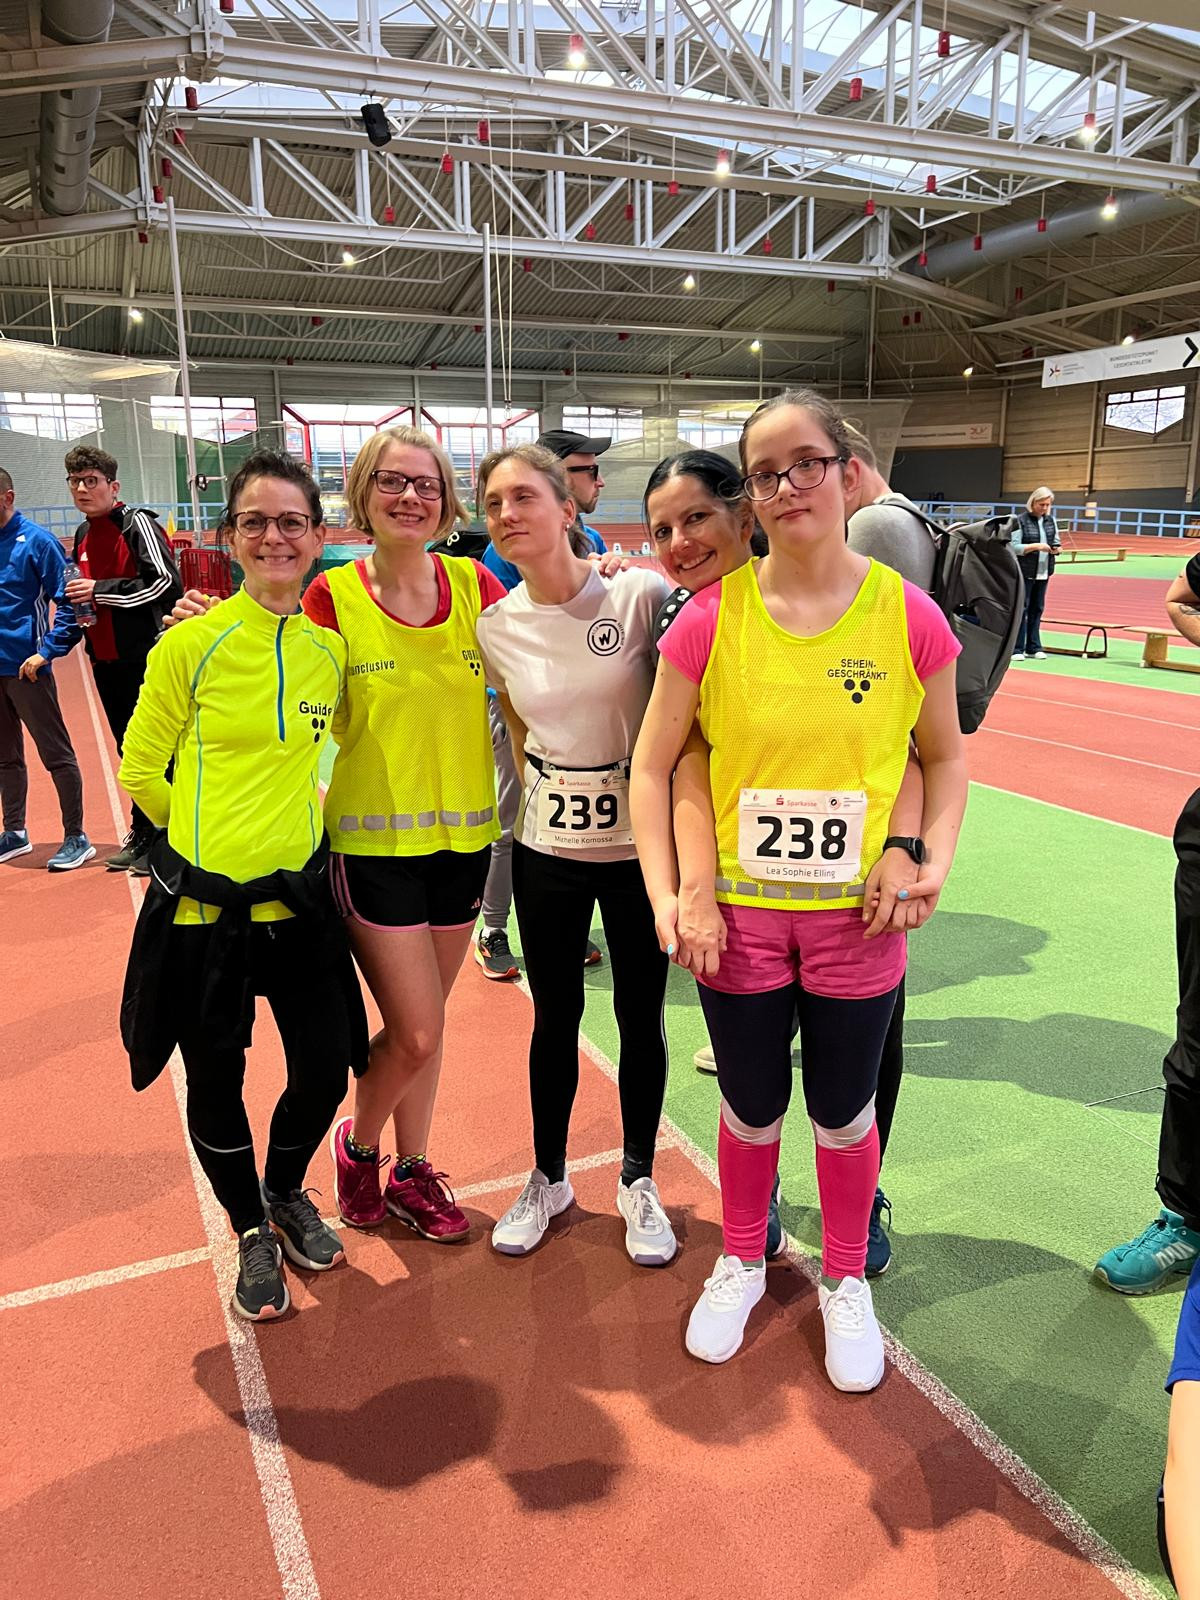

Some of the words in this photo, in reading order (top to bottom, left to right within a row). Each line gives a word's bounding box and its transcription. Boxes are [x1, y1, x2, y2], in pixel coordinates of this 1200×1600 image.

[827, 668, 887, 680] GESCHRÄNKT
[787, 799, 817, 808] Sparkasse
[548, 793, 618, 831] 239
[756, 815, 848, 860] 238
[766, 866, 781, 875] Lea
[783, 867, 812, 877] Sophie
[813, 869, 836, 878] Elling
